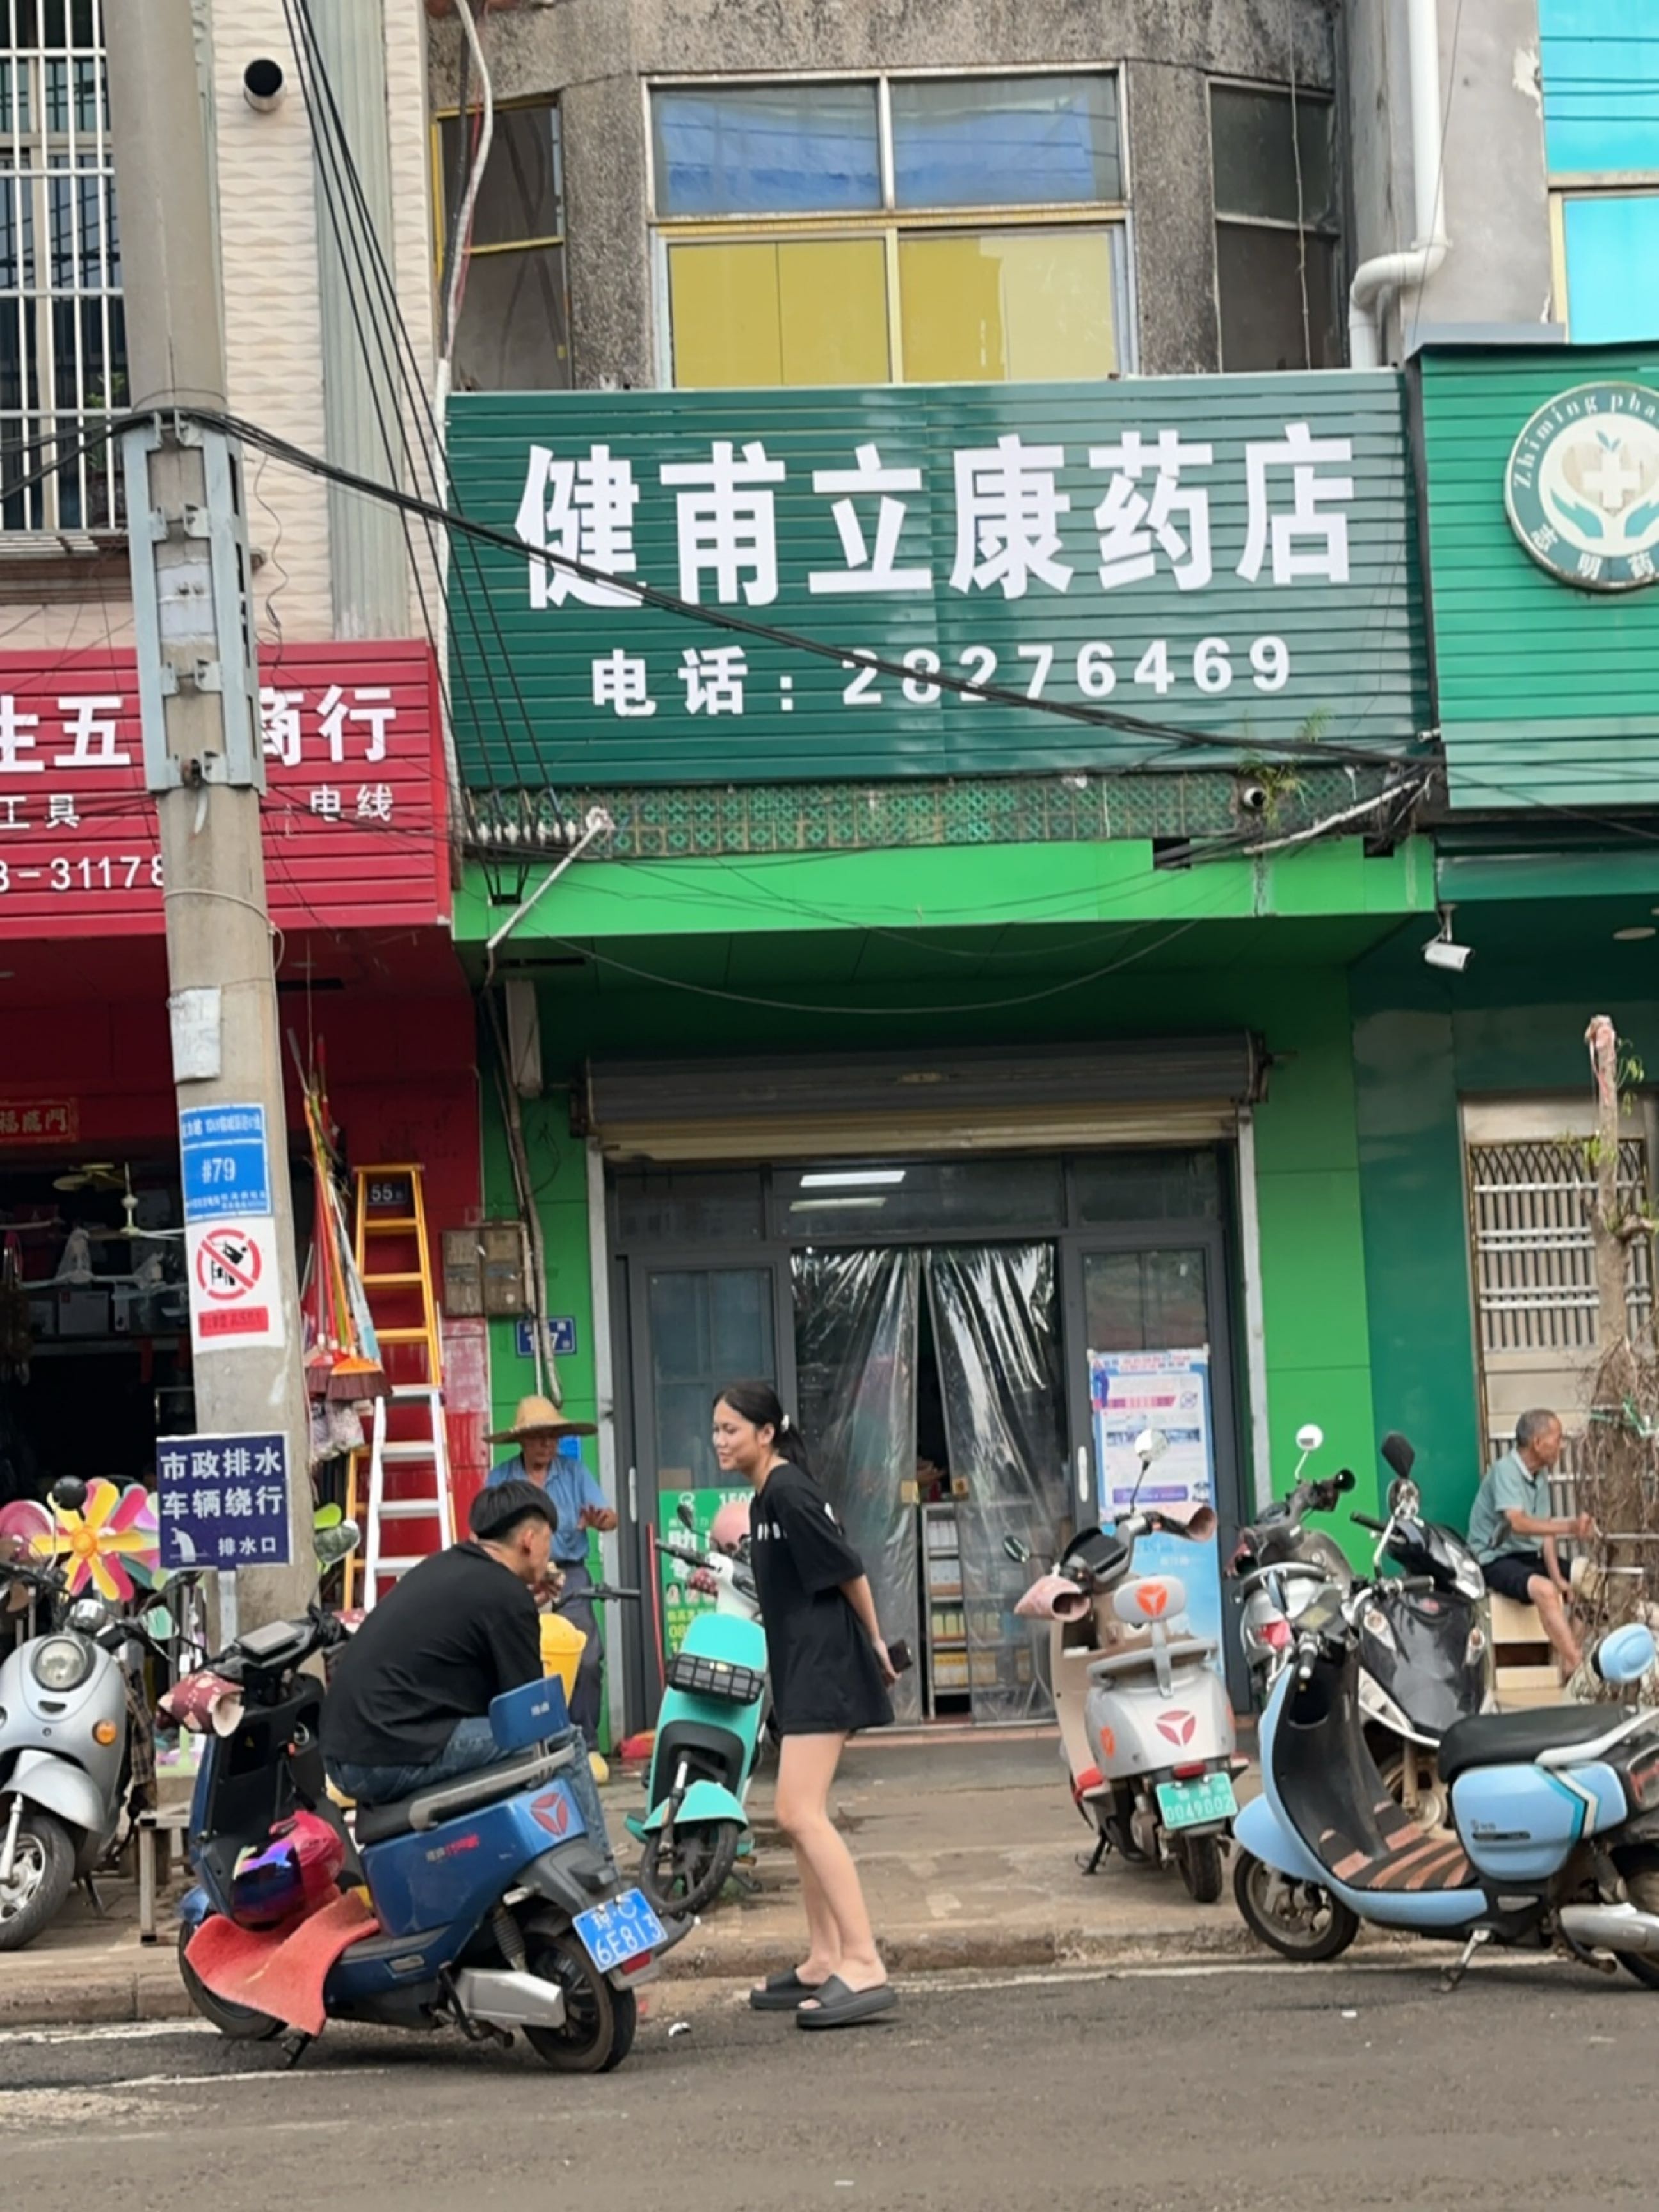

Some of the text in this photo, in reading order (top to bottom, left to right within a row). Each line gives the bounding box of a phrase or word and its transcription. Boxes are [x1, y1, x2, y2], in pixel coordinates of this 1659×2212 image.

[1611, 392, 1659, 424] pha
[515, 422, 1354, 609] 健甫立康药店
[310, 784, 393, 822] 电线
[202, 1157, 236, 1185] #79
[161, 1447, 282, 1481] 市政排水
[161, 1486, 283, 1521] 车辆绕行
[218, 1536, 276, 1557] 排水口
